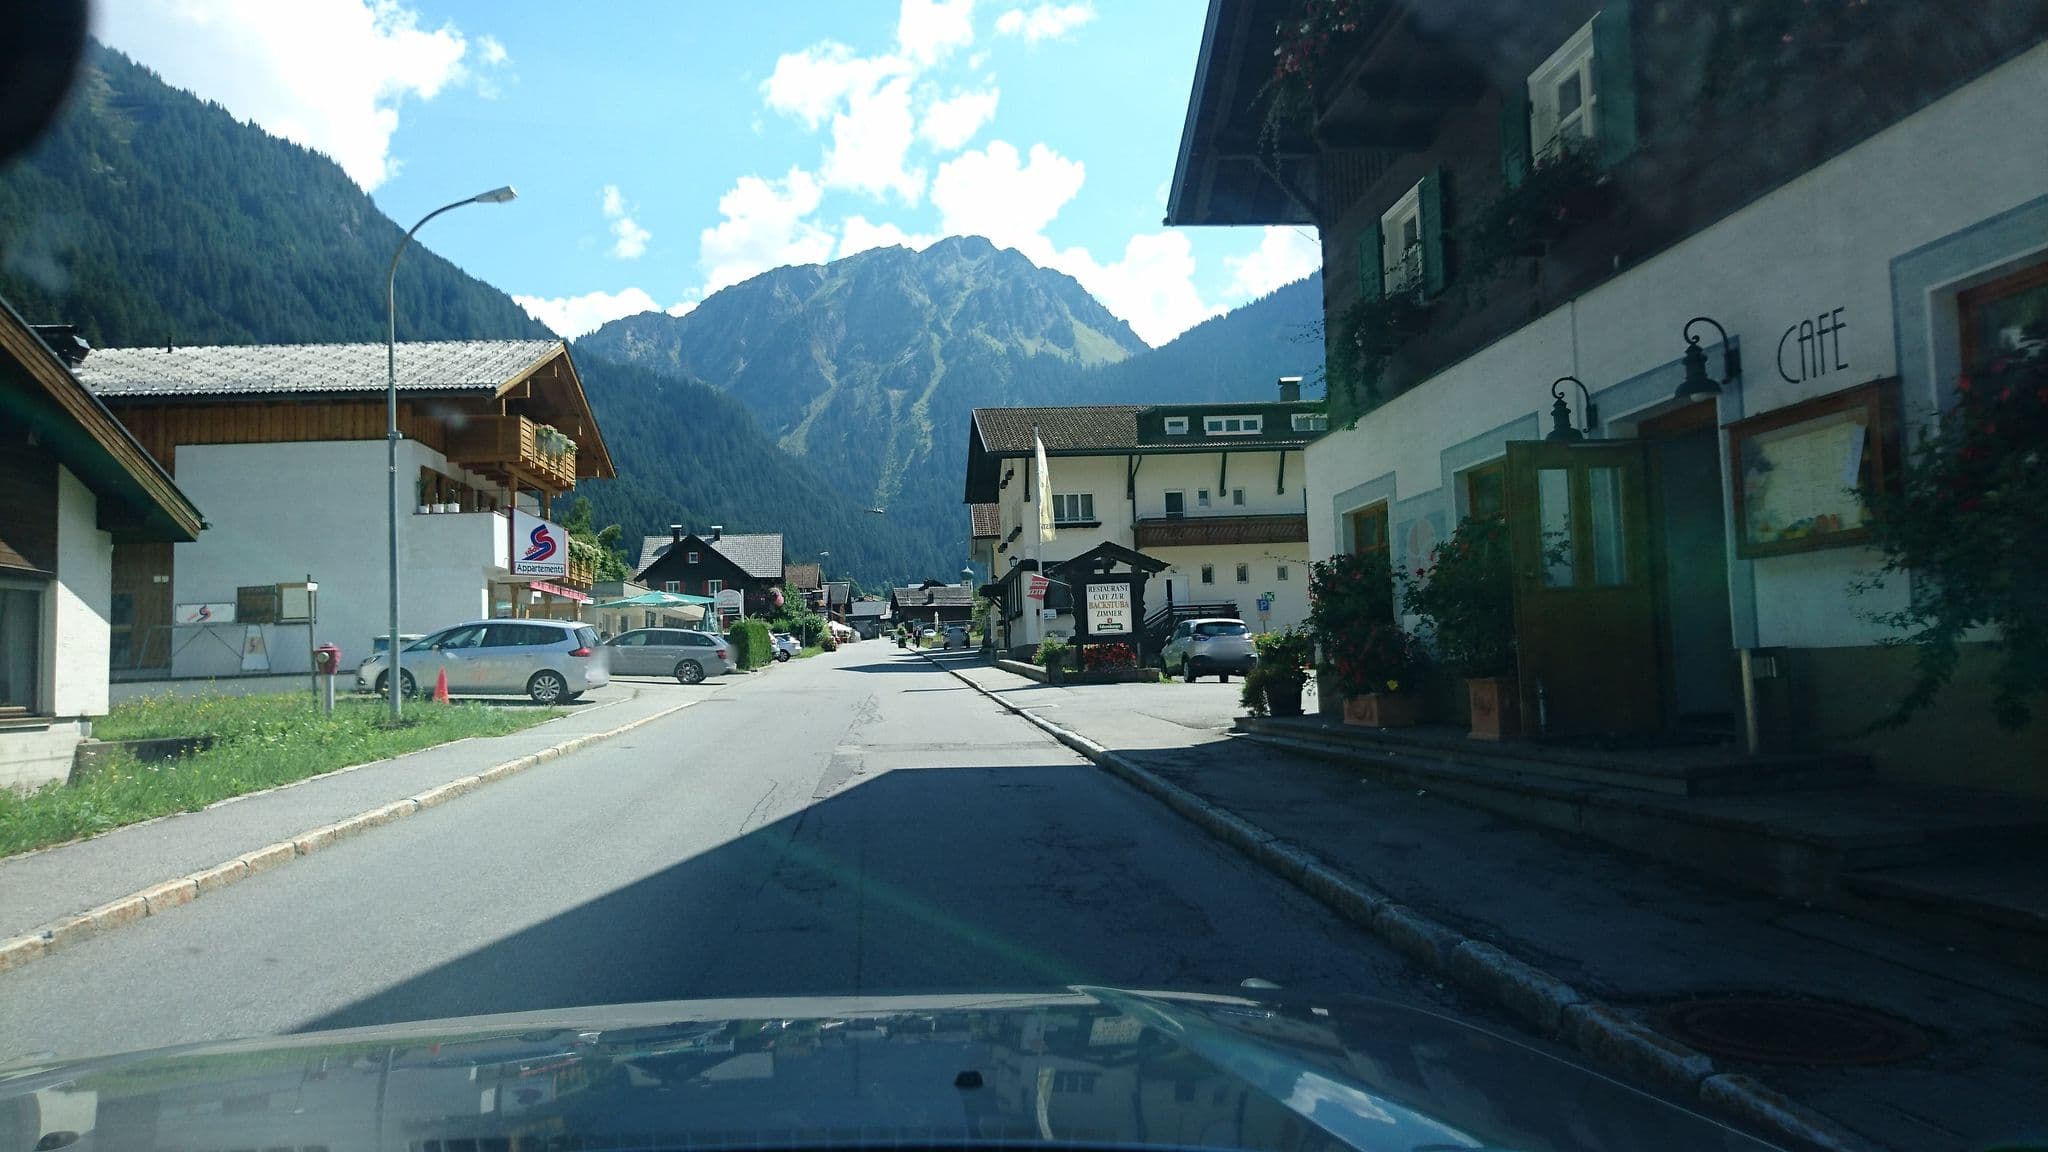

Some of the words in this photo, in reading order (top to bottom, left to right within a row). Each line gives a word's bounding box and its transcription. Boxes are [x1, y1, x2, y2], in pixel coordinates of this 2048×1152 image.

[1778, 306, 1848, 384] CAFE
[516, 563, 564, 574] Appartements
[1088, 601, 1129, 609] BACKSTUBA
